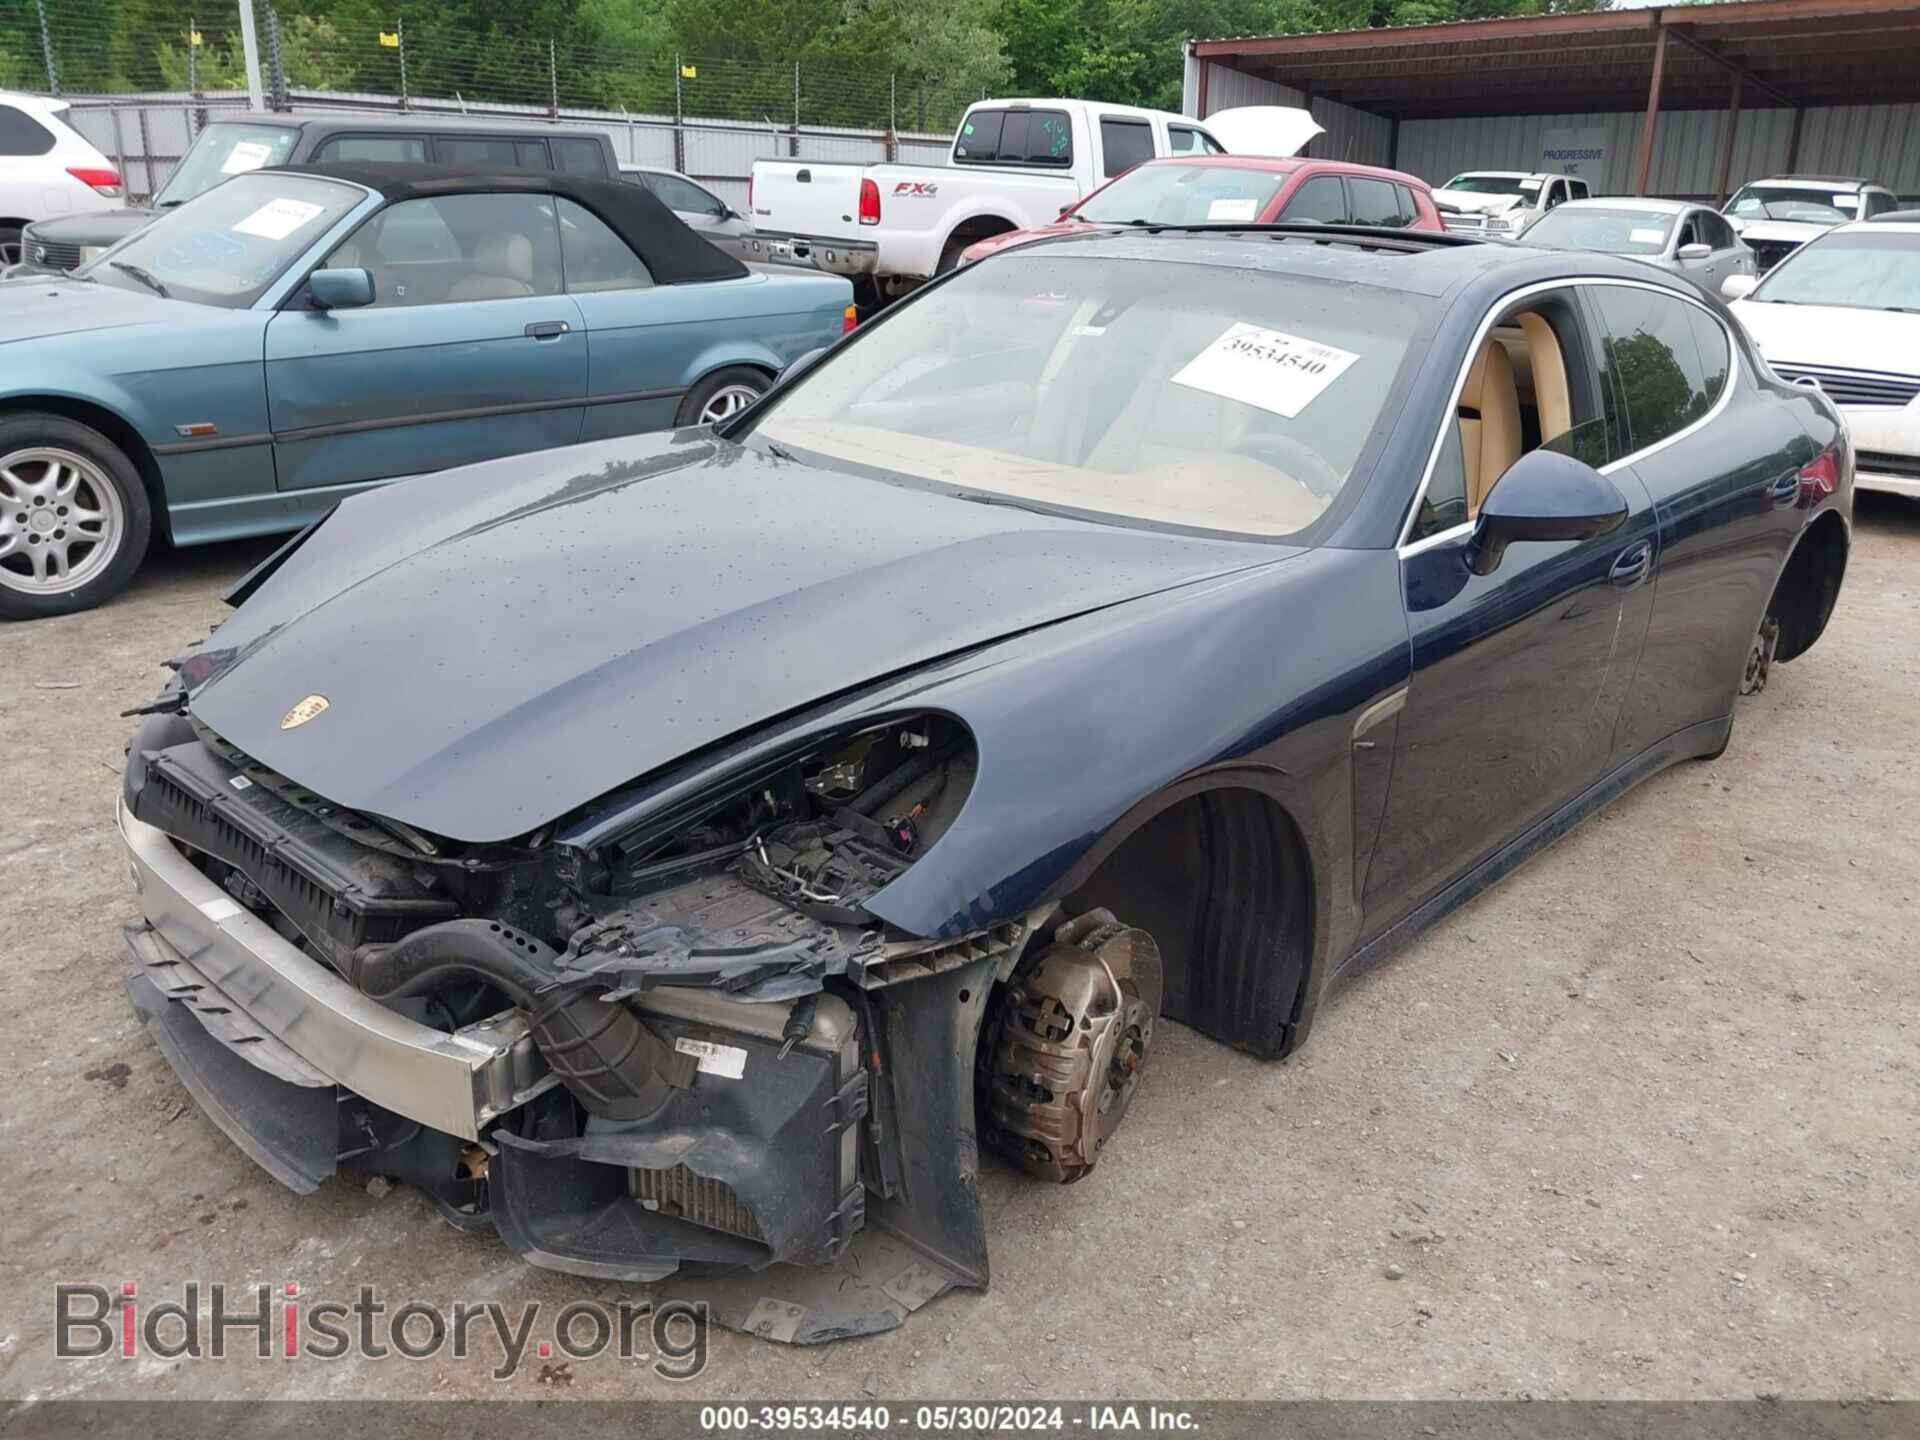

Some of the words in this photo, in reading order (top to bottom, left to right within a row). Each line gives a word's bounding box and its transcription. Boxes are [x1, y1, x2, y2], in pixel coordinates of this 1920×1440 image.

[1542, 149, 1605, 161] PROGRESSIVE
[894, 182, 939, 194] FX4
[1222, 338, 1328, 375] 39534540
